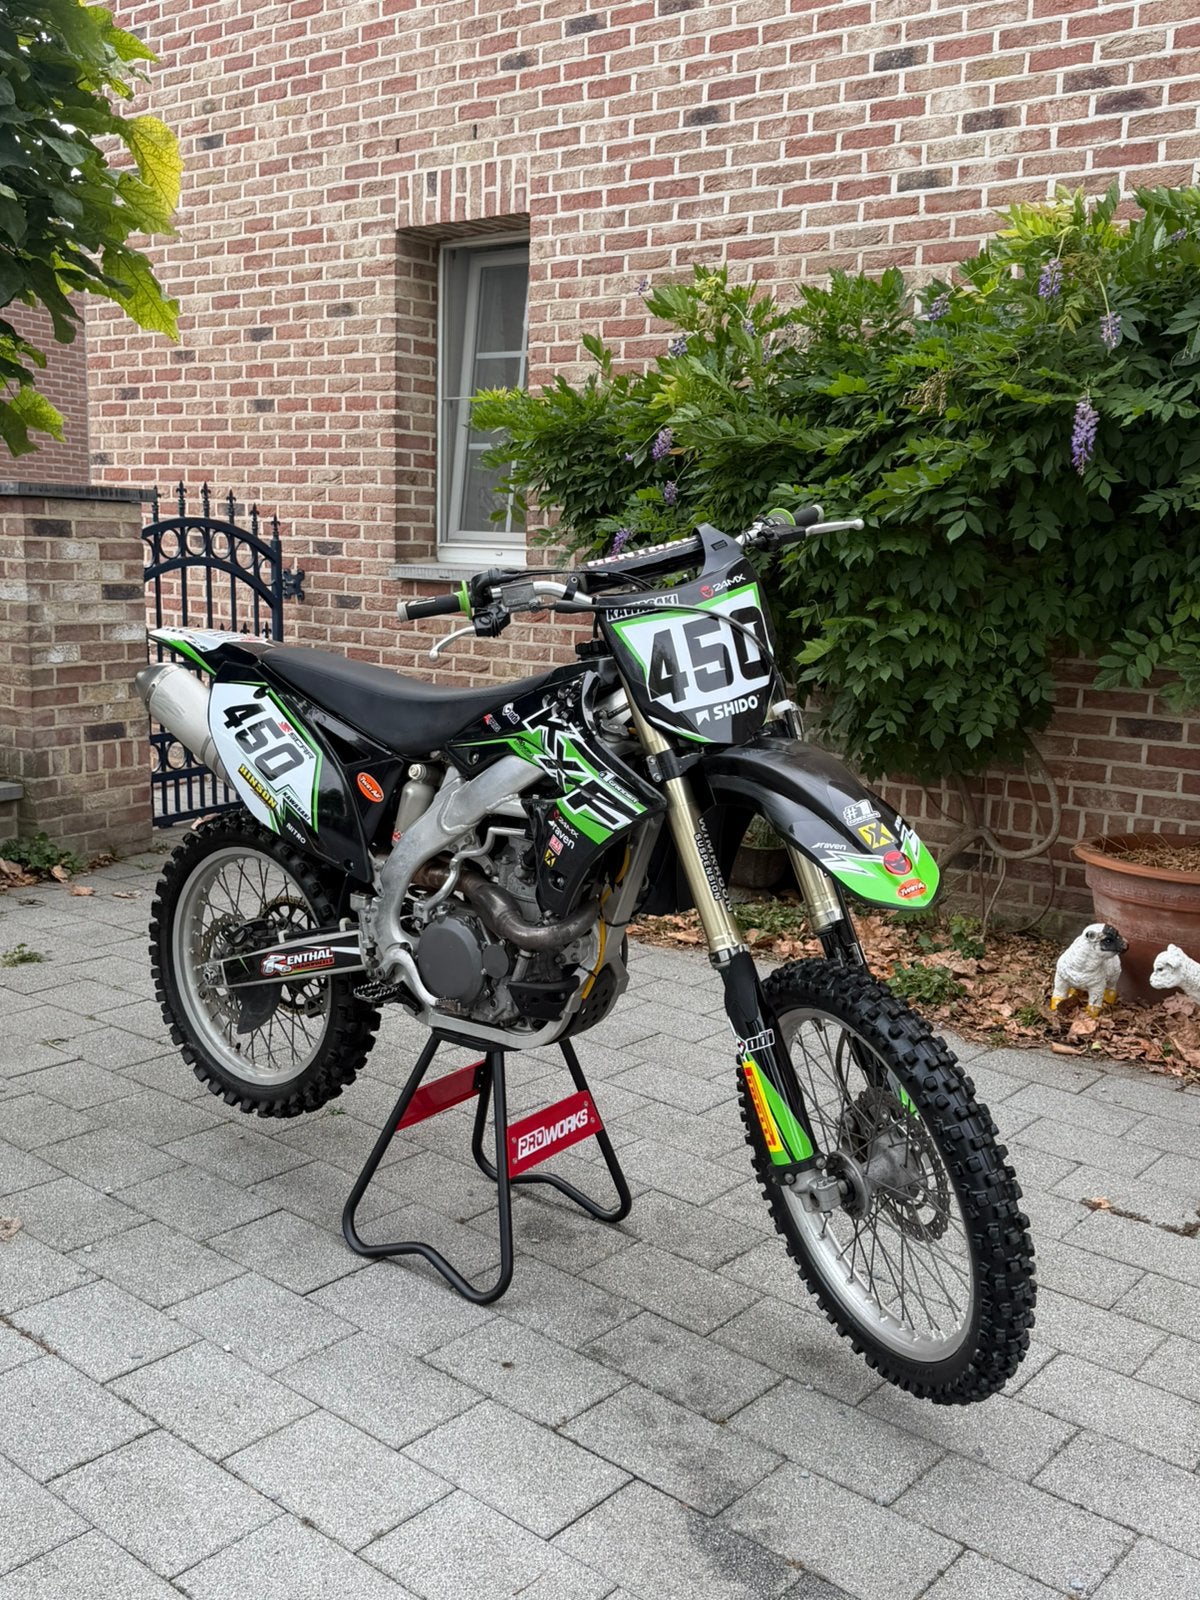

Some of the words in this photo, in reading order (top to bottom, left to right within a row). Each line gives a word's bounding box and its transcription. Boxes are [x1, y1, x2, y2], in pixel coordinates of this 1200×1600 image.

[713, 573, 746, 592] 24MX
[649, 604, 771, 704] 450
[714, 698, 758, 720] SHIDO
[222, 703, 305, 781] 450
[238, 763, 277, 810] HINSON
[282, 791, 312, 821] KAWASAKI
[286, 822, 306, 844] NITRO
[552, 824, 576, 850] raven
[818, 842, 847, 851] raven
[694, 832, 721, 901] SUSPENSION
[261, 948, 334, 976] RENTHAL
[517, 1108, 588, 1160] PROWORKS
